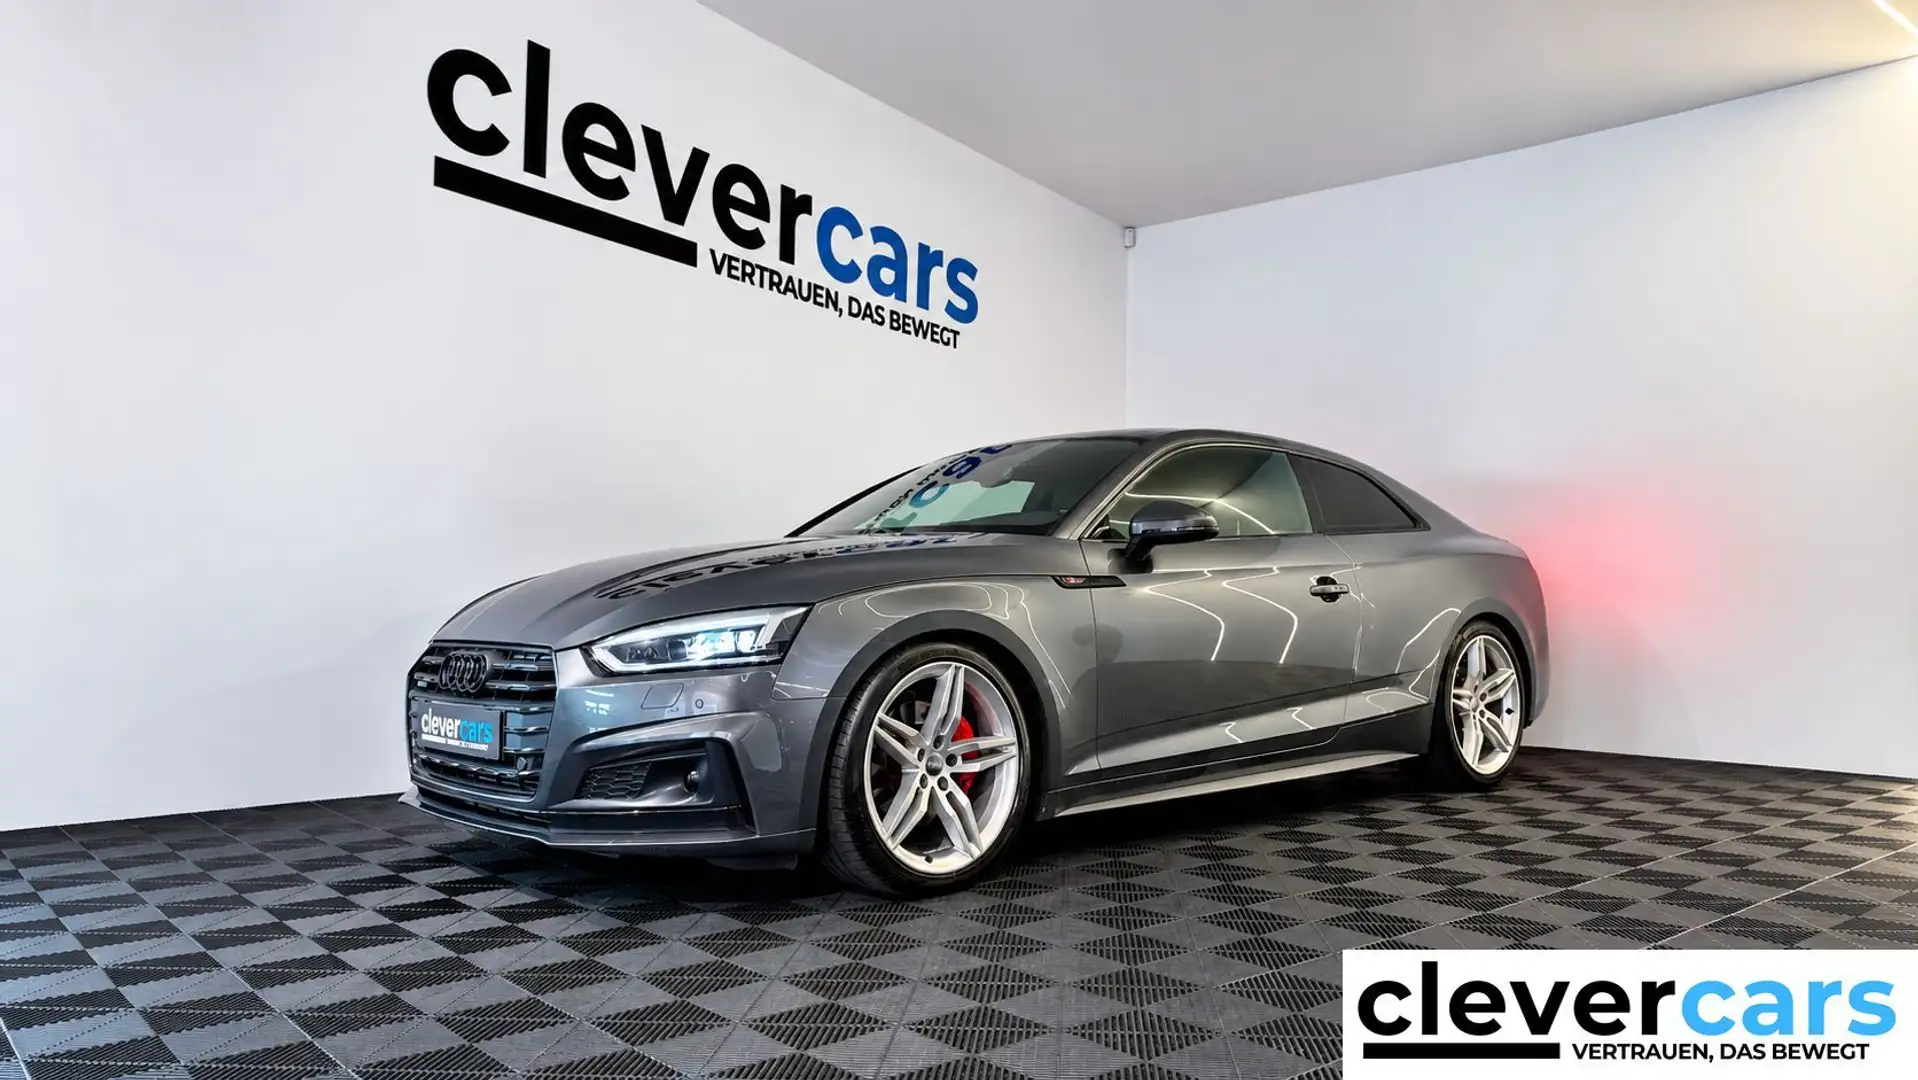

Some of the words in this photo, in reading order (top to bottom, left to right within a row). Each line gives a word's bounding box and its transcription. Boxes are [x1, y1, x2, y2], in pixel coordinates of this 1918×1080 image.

[427, 39, 979, 324] clevercars
[709, 248, 844, 318] VERTRAUEN,
[847, 295, 886, 327] DAS
[889, 309, 961, 349] BEWEGT
[421, 708, 493, 743] clevercars
